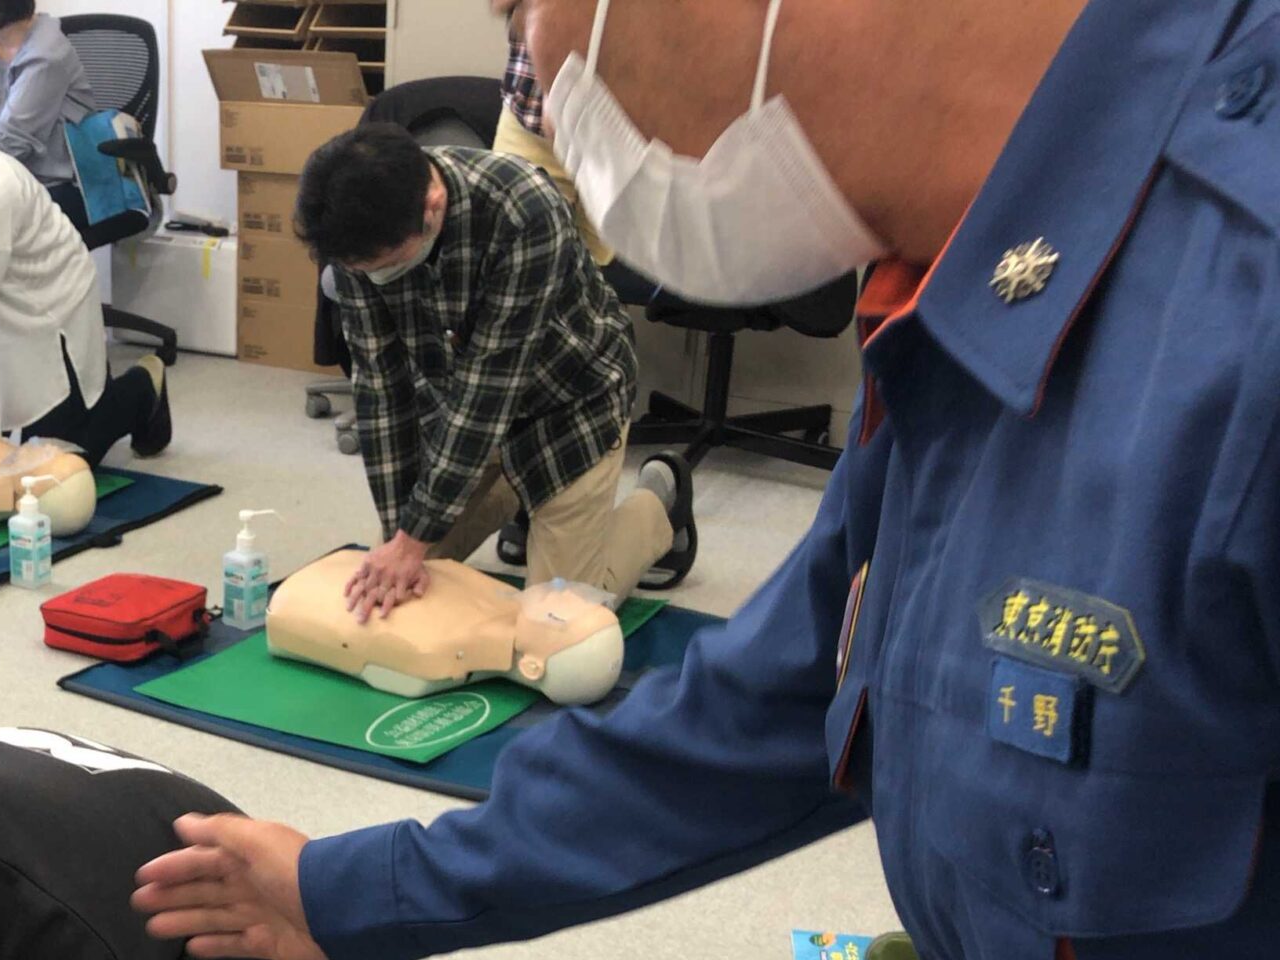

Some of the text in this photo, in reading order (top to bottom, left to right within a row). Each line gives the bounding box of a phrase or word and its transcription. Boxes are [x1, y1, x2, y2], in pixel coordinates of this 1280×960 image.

[993, 590, 1119, 674] 東京消防庁
[997, 686, 1059, 737] 千野
